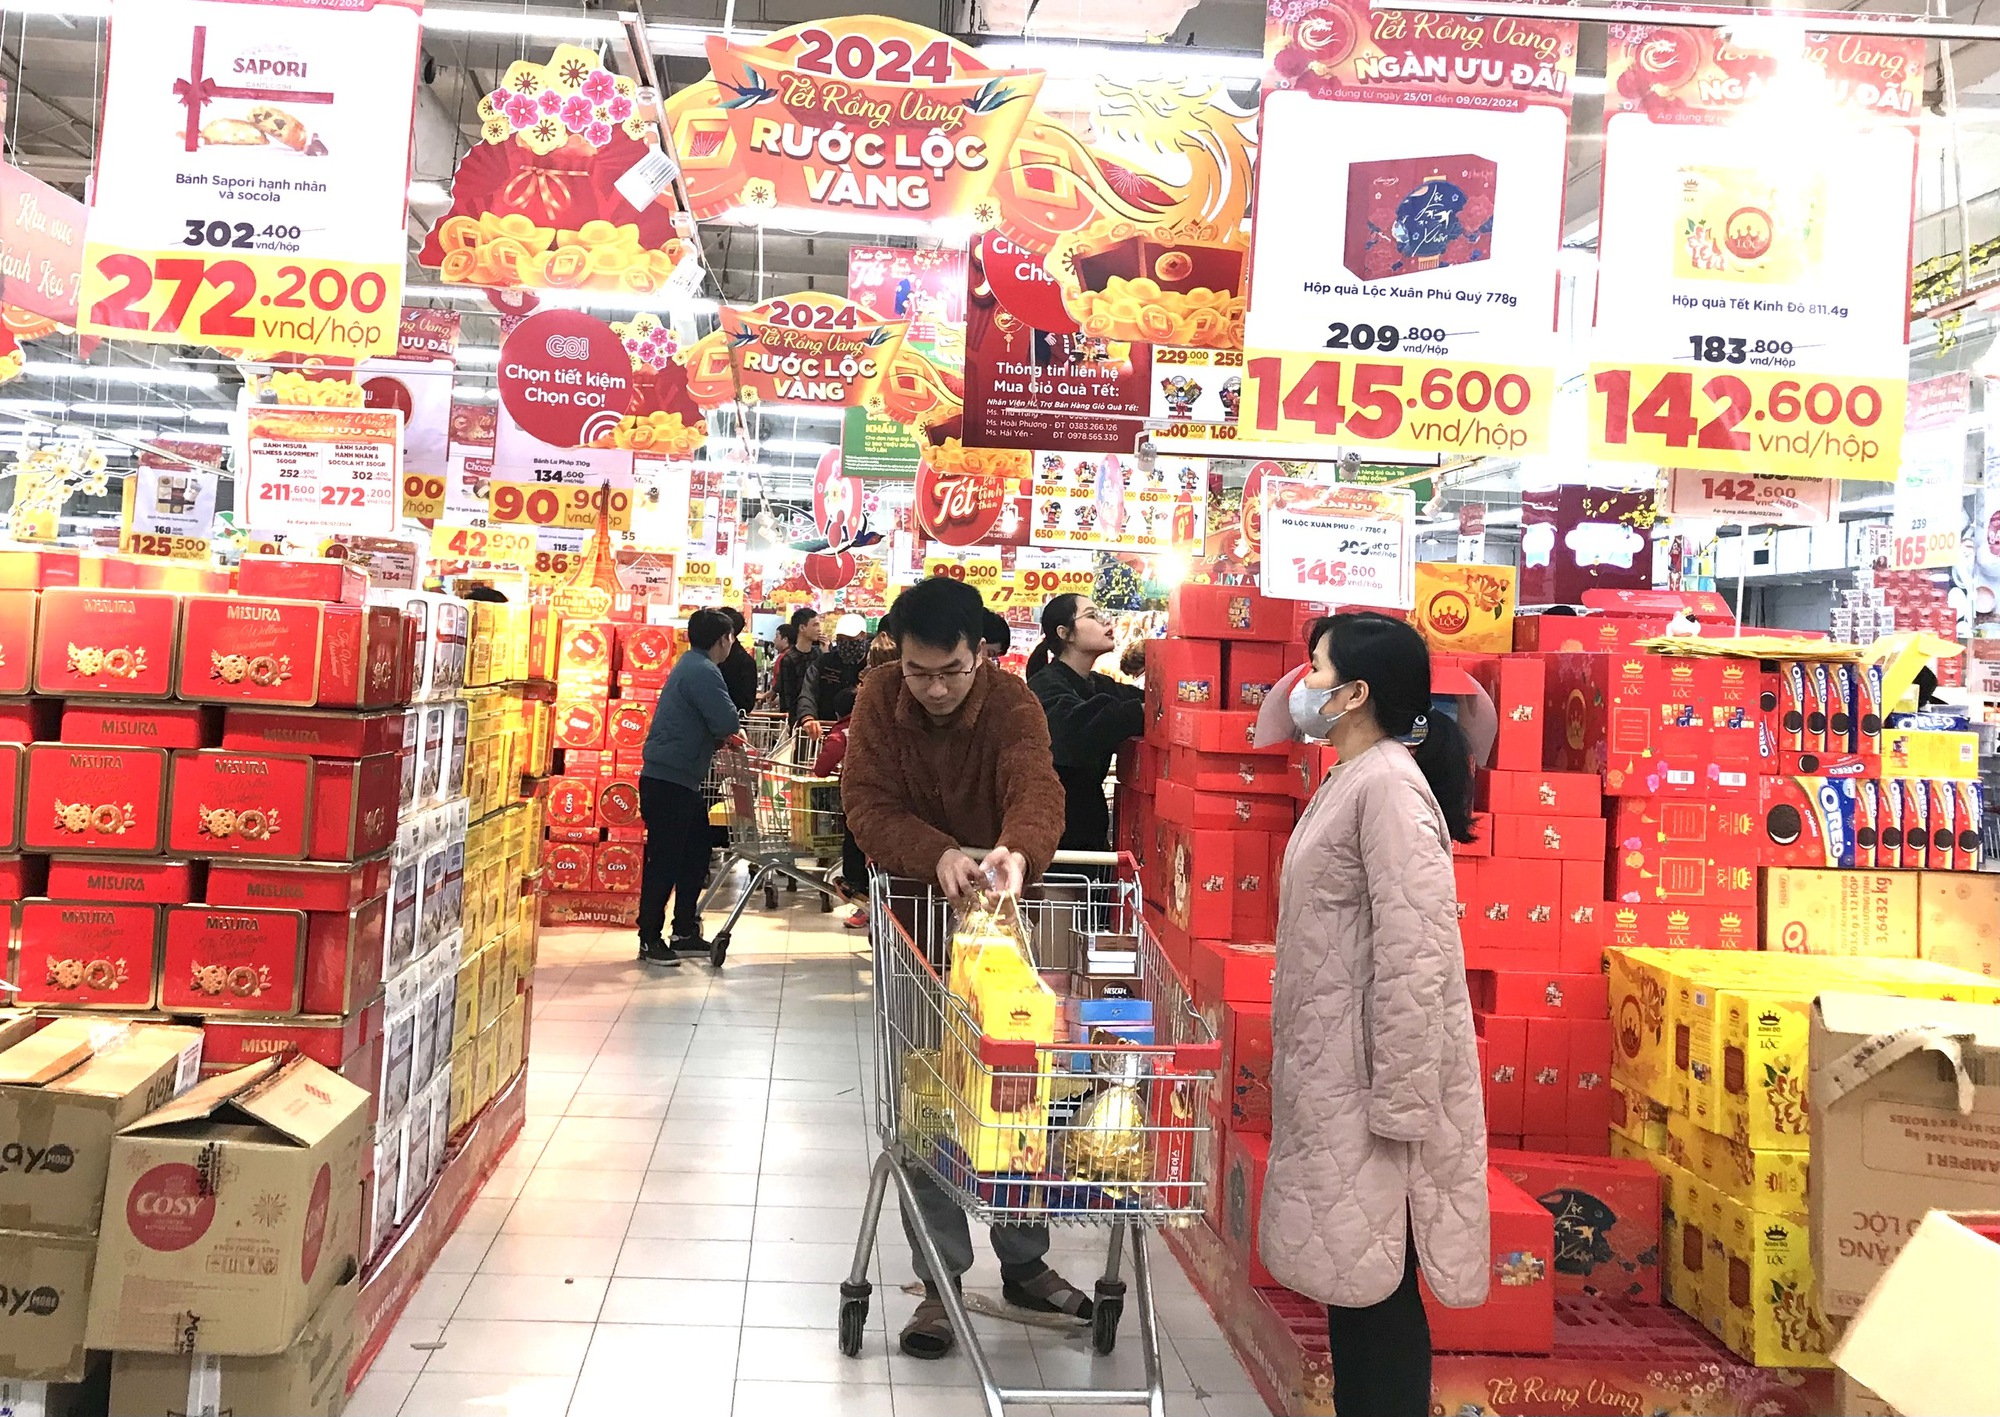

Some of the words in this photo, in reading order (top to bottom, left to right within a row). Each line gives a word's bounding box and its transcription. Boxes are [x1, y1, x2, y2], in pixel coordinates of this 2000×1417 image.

[1371, 11, 1407, 41] Tết
[1414, 14, 1484, 50] Rồng
[1493, 19, 1557, 58] Vàng
[233, 57, 308, 78] SAPORI
[797, 29, 953, 83] 2024
[1354, 50, 1449, 84] NGÀN
[1454, 55, 1504, 83] ƯU
[1510, 57, 1567, 93] ĐÃI
[779, 74, 816, 108] Tết
[822, 84, 892, 129] Rồng
[900, 90, 965, 131] Vàng
[1318, 87, 1332, 99] Áp
[1334, 89, 1361, 102] dụng
[1376, 91, 1400, 102] ngày
[1403, 92, 1433, 104] 25/01
[1456, 96, 1519, 109] 09/02/2024
[750, 117, 886, 166] RƯỚC
[894, 131, 988, 180] LỘC
[176, 174, 207, 187] Bánh
[212, 175, 254, 190] Sapori
[259, 178, 290, 192] hạnh
[295, 180, 327, 193] nhân
[219, 189, 235, 200] và
[238, 190, 280, 203] socola
[803, 163, 931, 209] VÀNG
[183, 220, 301, 249] 302.400
[256, 240, 300, 253] vnd/hộp
[90, 253, 388, 338] 272.200
[1304, 282, 1331, 297] Hộp
[1334, 284, 1359, 297] quà
[1363, 285, 1387, 300] Lộc
[1390, 286, 1423, 299] Xuân
[1427, 288, 1451, 301] Phú
[1455, 290, 1481, 304] Quý
[1486, 292, 1517, 307] 778g
[1672, 294, 1698, 309] Hộp
[1702, 296, 1726, 310] quà
[1730, 298, 1750, 311] Tết
[1753, 300, 1783, 312] Kinh
[1787, 302, 1805, 315] Đô
[1809, 304, 1849, 318] 811.4g
[769, 300, 857, 330] 2024
[262, 317, 381, 347] vnd/hộp
[401, 335, 425, 349] ƯU
[427, 340, 454, 354] ĐÃI
[760, 326, 781, 346] Tết
[784, 331, 822, 356] Rồng
[827, 335, 865, 358] Vàng
[1326, 322, 1446, 352] 209.800
[549, 337, 589, 359] GO!
[1156, 349, 1209, 364] 229.000
[1403, 344, 1449, 356] vnd/Hộp
[1689, 335, 1793, 365] 183.800
[505, 363, 549, 382] Chọn
[554, 368, 582, 383] tiết
[586, 370, 626, 390] kiệm
[743, 351, 819, 377] RƯỚC
[825, 356, 877, 383] LỘC
[996, 361, 1042, 379] Thông
[1046, 364, 1066, 377] tin
[1070, 364, 1096, 378] liên
[1101, 366, 1119, 382] hệ
[1750, 357, 1796, 369] vnd/Hộp
[525, 387, 568, 407] Chọn
[573, 393, 605, 408] GO!
[773, 376, 845, 401] VÀNG
[994, 380, 1023, 393] Mua
[1029, 381, 1052, 395] Giỏ
[1058, 384, 1086, 398] Quà
[1092, 383, 1120, 397] Tết:
[1247, 356, 1531, 439] 145.600
[1594, 369, 1883, 452] 142.600
[1068, 432, 1119, 442] 0978.565.330
[1410, 417, 1527, 449] vnd/hộp
[1758, 429, 1879, 463] vnd/hộp
[260, 483, 315, 501] 211.600
[321, 486, 391, 506] 272.200
[933, 477, 979, 527] Tết
[1702, 477, 1796, 502] 142.600
[131, 534, 206, 557] 125.500
[1024, 571, 1094, 591] 90.400
[1791, 666, 1804, 702] OREO
[1815, 667, 1828, 704] OREO
[1837, 668, 1851, 704] OREO
[1868, 668, 1882, 705] OREO
[1864, 782, 1877, 819] OREO
[1889, 782, 1902, 819] OREO
[1914, 782, 1927, 820] OREO
[1804, 809, 1819, 838] Original
[1819, 785, 1845, 859] OREO
[1872, 876, 1893, 895] kg
[1876, 895, 1889, 944] 3,6432
[136, 1191, 205, 1217] COSY
[1853, 1210, 1900, 1237] LỘC
